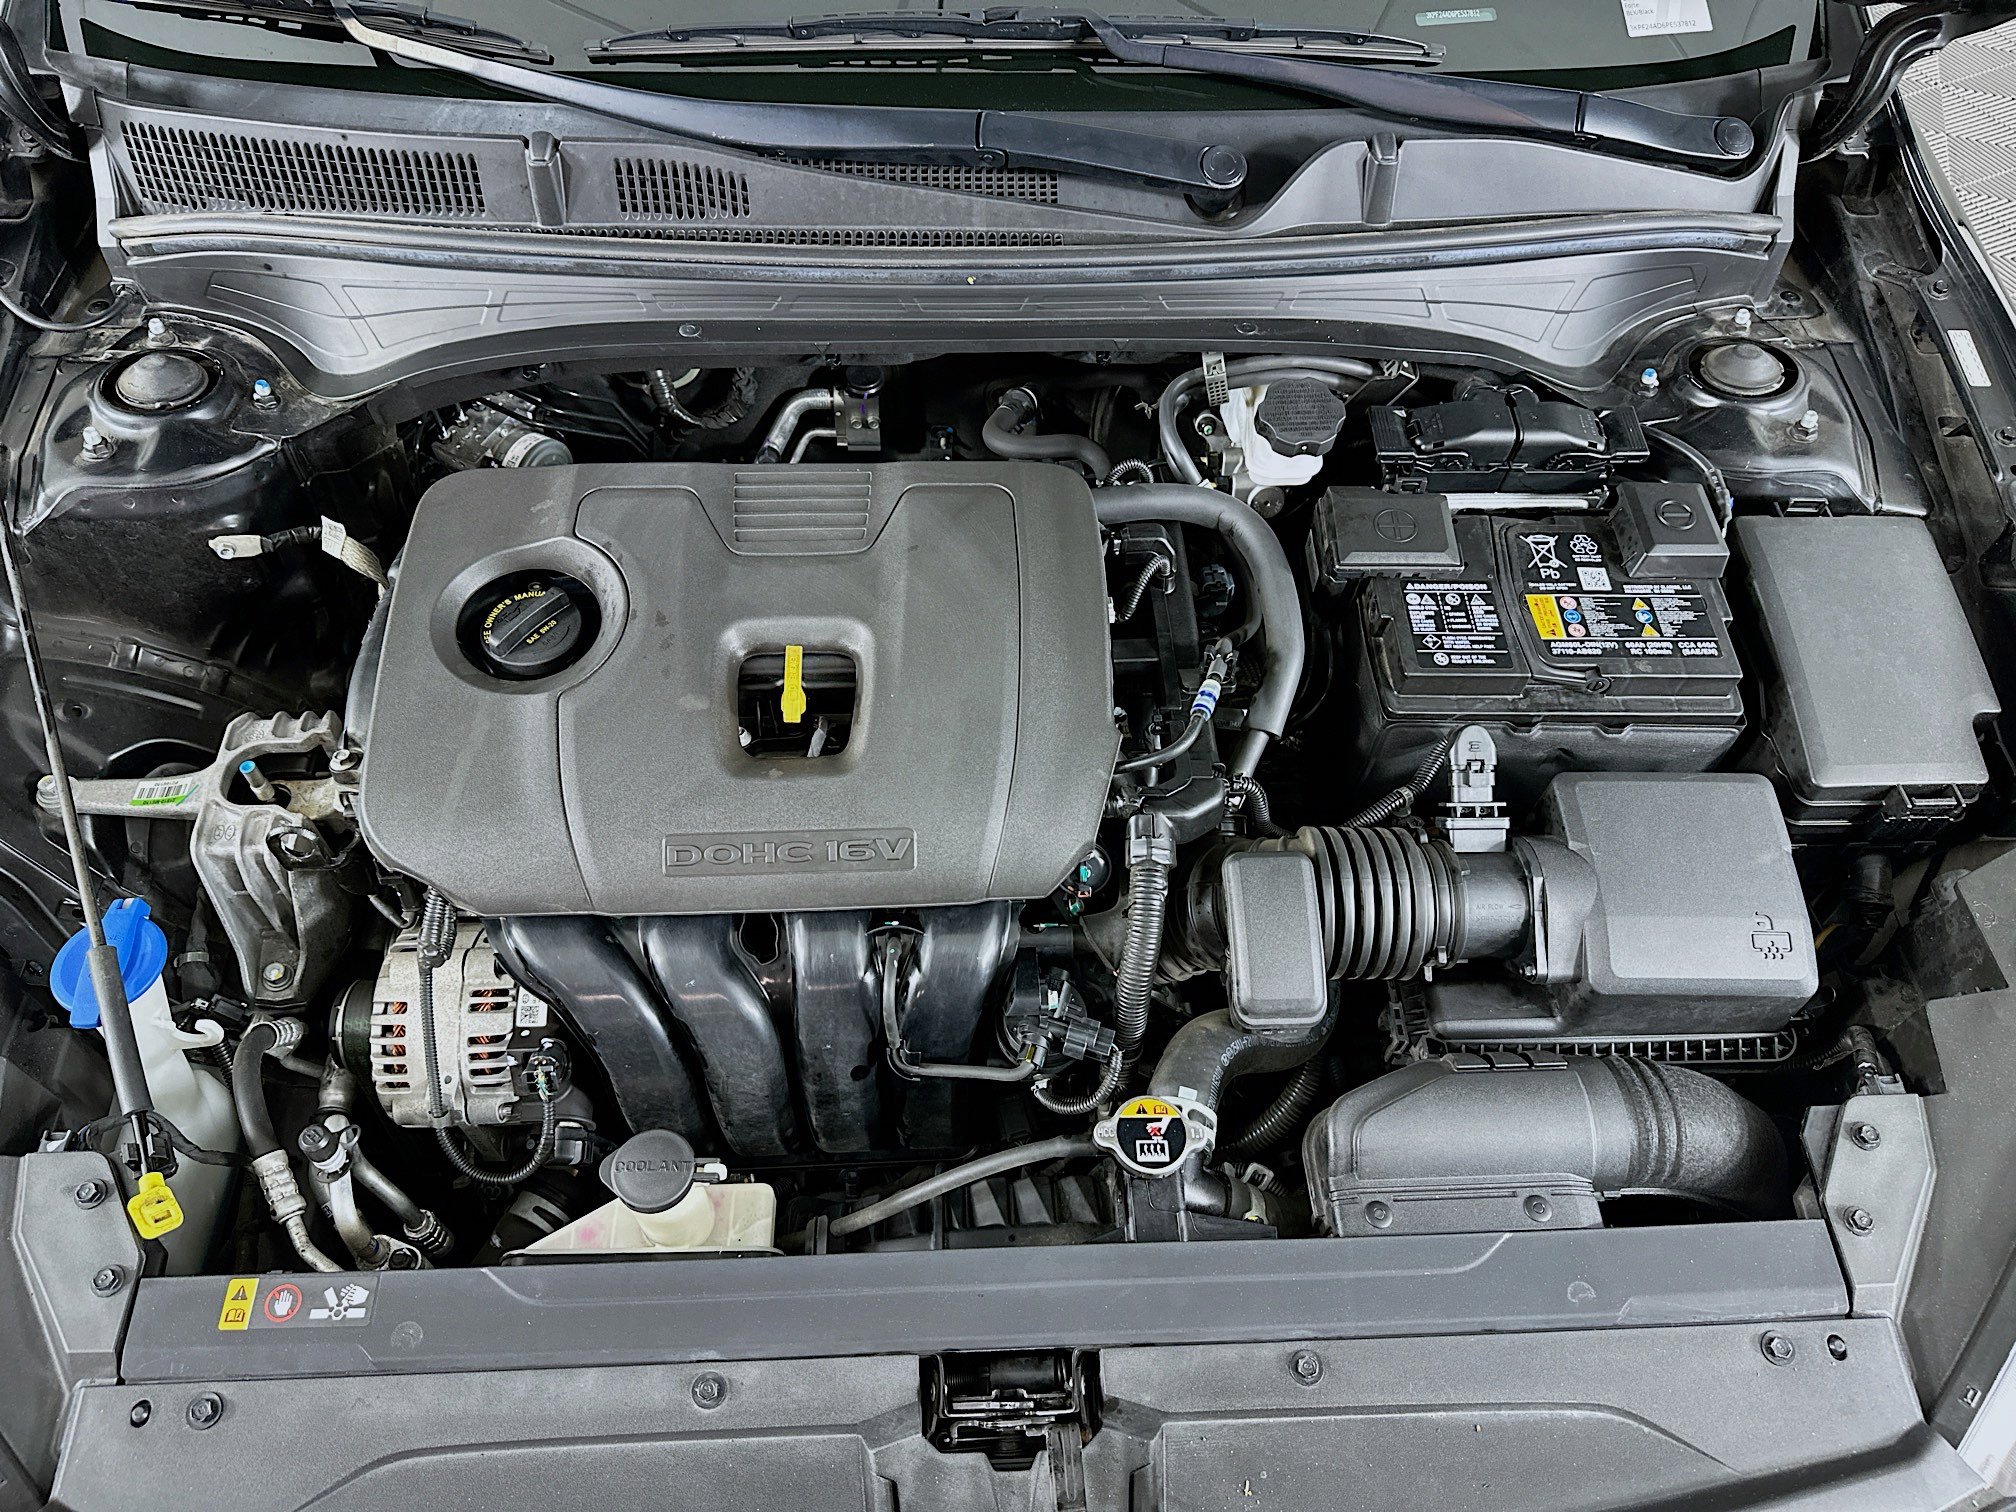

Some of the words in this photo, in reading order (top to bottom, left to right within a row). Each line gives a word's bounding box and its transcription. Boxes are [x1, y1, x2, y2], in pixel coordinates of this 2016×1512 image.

[1540, 568, 1561, 579] Pb
[484, 598, 512, 628] OWNER'S
[526, 633, 540, 644] SAE
[1678, 641, 1696, 649] CCA
[666, 841, 813, 866] DOHC
[826, 837, 912, 863] 16V
[1097, 1127, 1116, 1138] HCC
[615, 1160, 692, 1173] COOLANT
